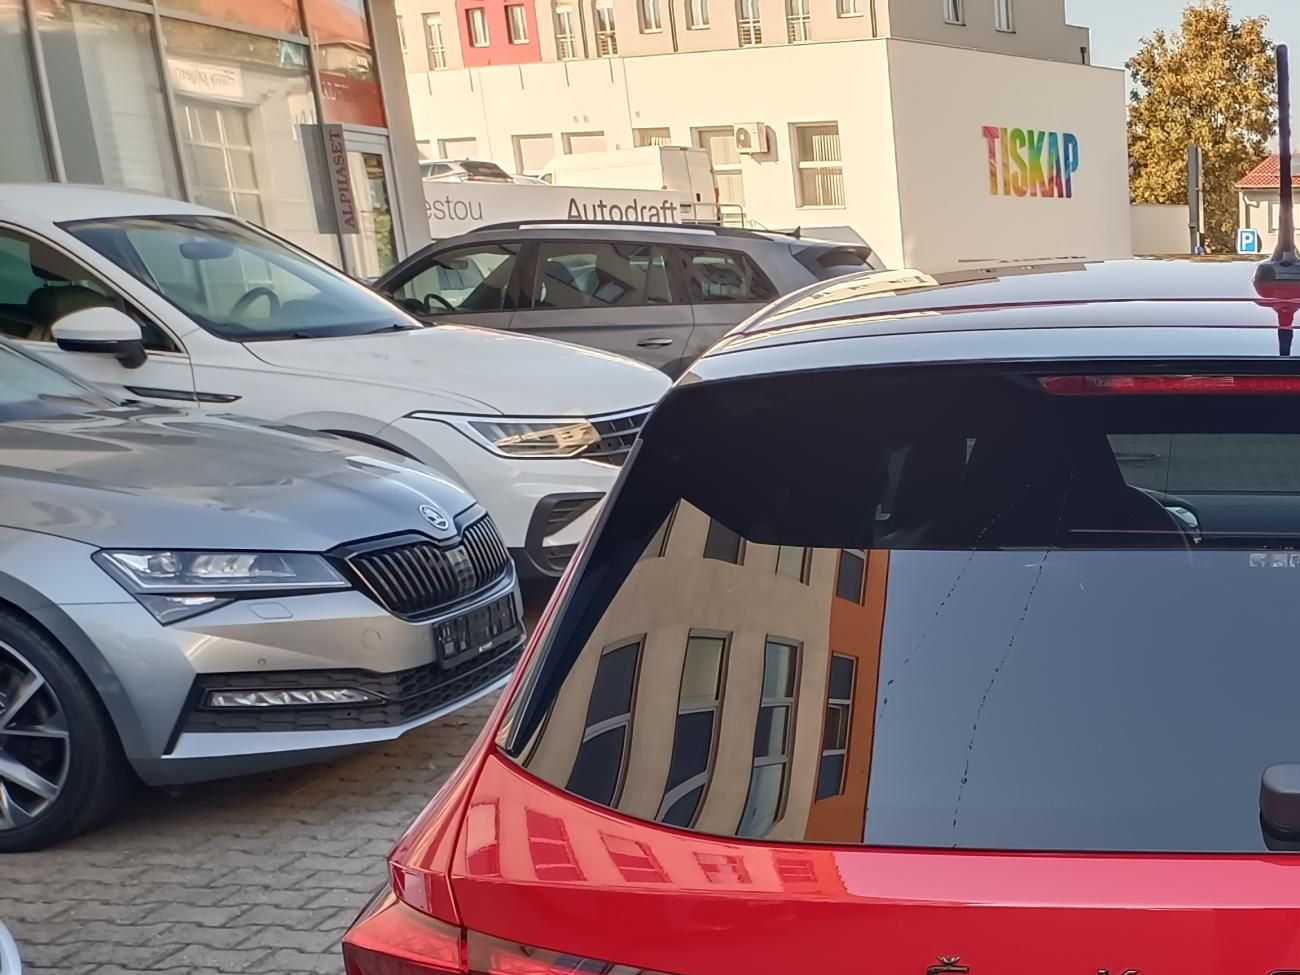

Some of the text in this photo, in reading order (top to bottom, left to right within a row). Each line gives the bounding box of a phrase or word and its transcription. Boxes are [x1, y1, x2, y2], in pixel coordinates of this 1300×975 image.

[329, 129, 356, 229] ALPHASET
[982, 126, 1079, 198] TISKAP
[567, 197, 677, 224] Autodraft
[1241, 232, 1254, 251] P
